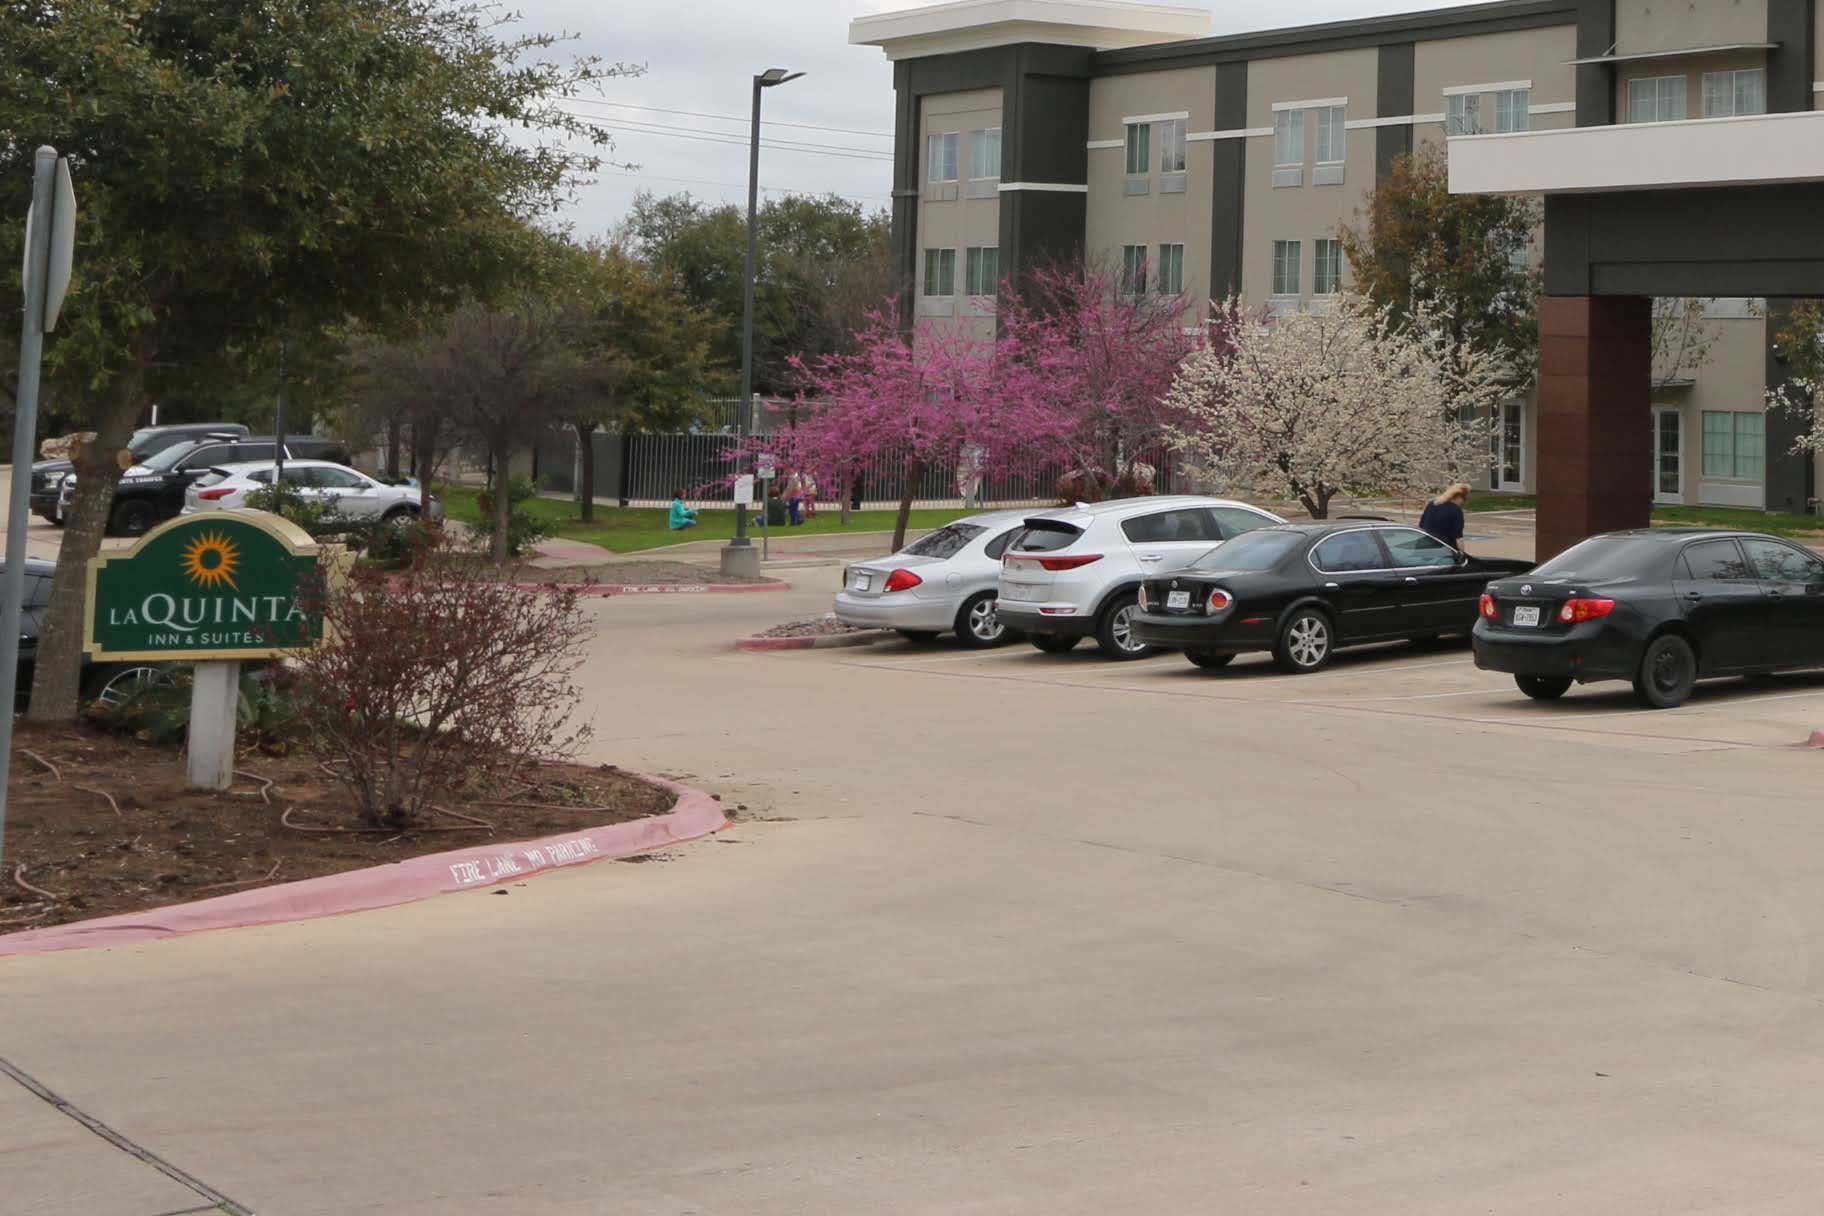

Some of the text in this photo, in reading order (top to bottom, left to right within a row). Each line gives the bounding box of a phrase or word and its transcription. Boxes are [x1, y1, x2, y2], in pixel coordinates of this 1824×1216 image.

[148, 632, 265, 645] INN & SUITES
[449, 858, 486, 884] FIRE
[485, 853, 521, 877] LANE
